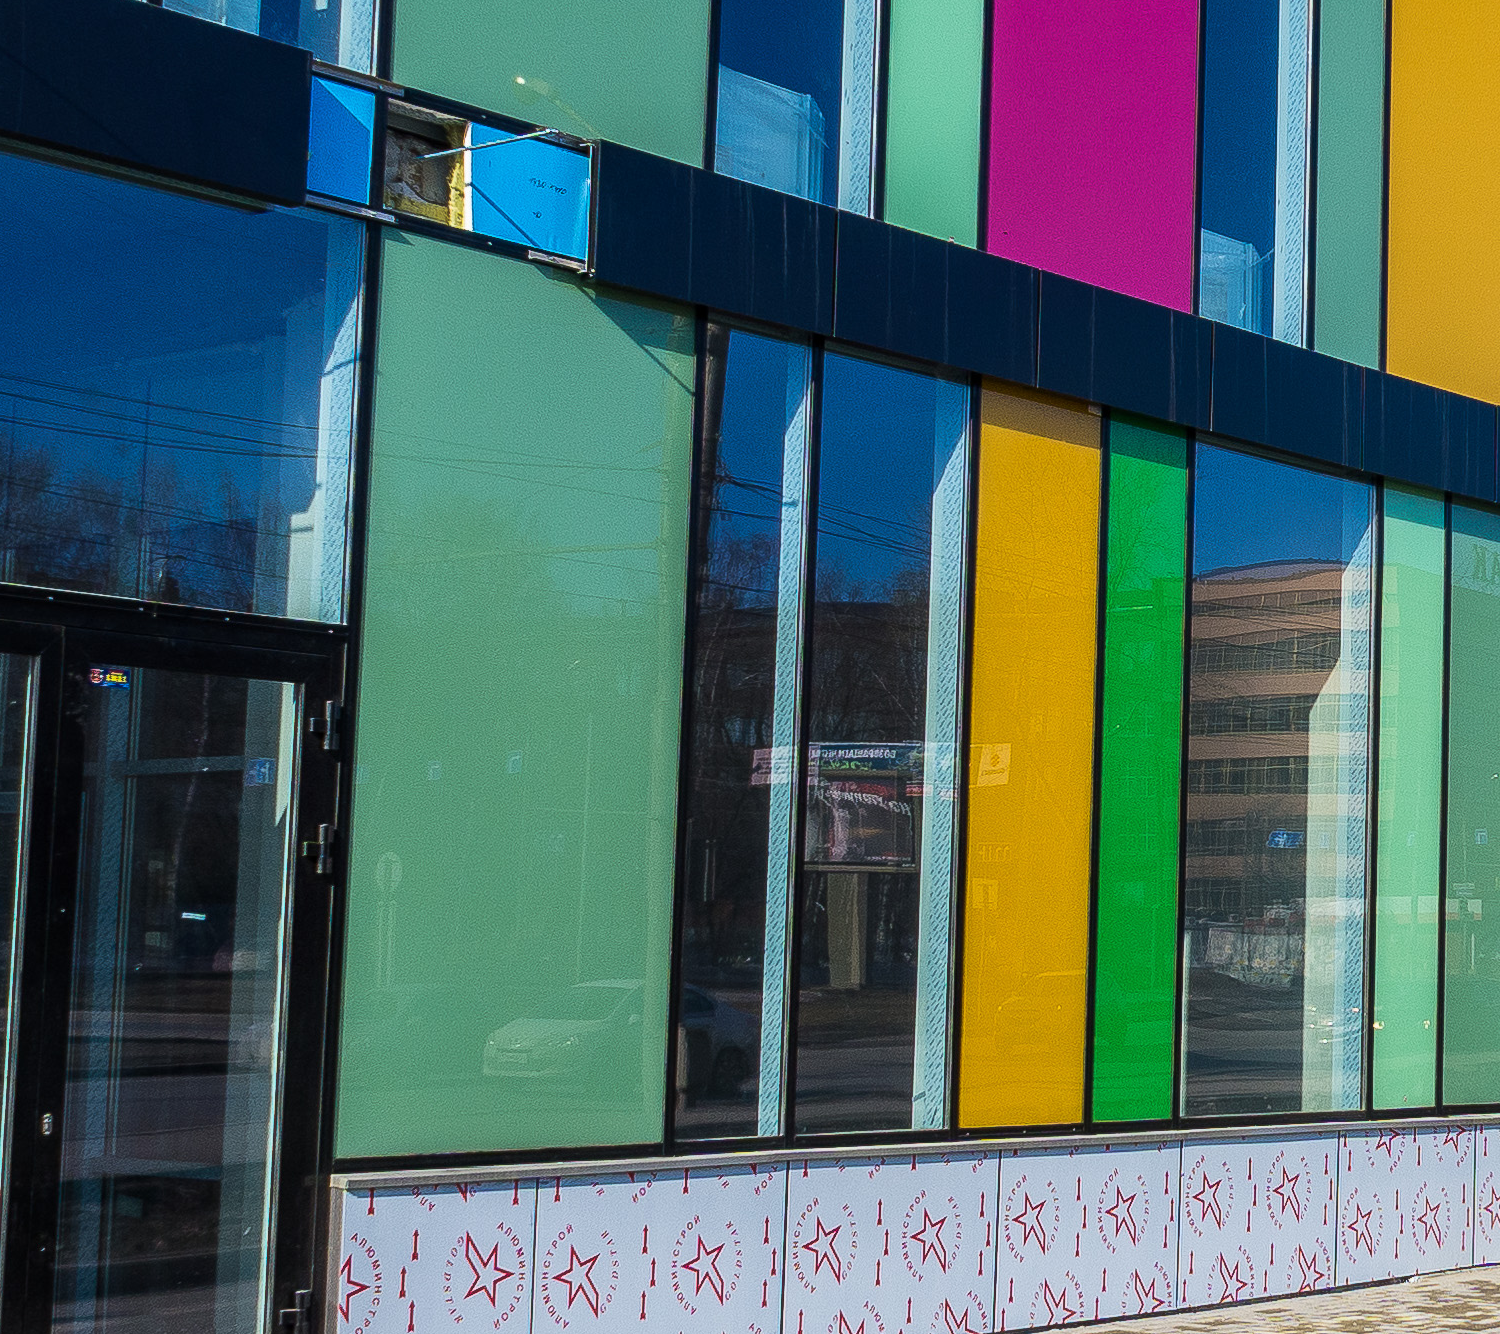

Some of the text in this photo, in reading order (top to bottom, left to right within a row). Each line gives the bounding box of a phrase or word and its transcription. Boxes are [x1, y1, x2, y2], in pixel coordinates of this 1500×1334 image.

[494, 1222, 526, 1329] АЛЮМИНСТРОЙ
[541, 1224, 574, 1329] АЛЮМИНСТРОЙ
[671, 1215, 700, 1315] АЛЮМИНСТРОЙ
